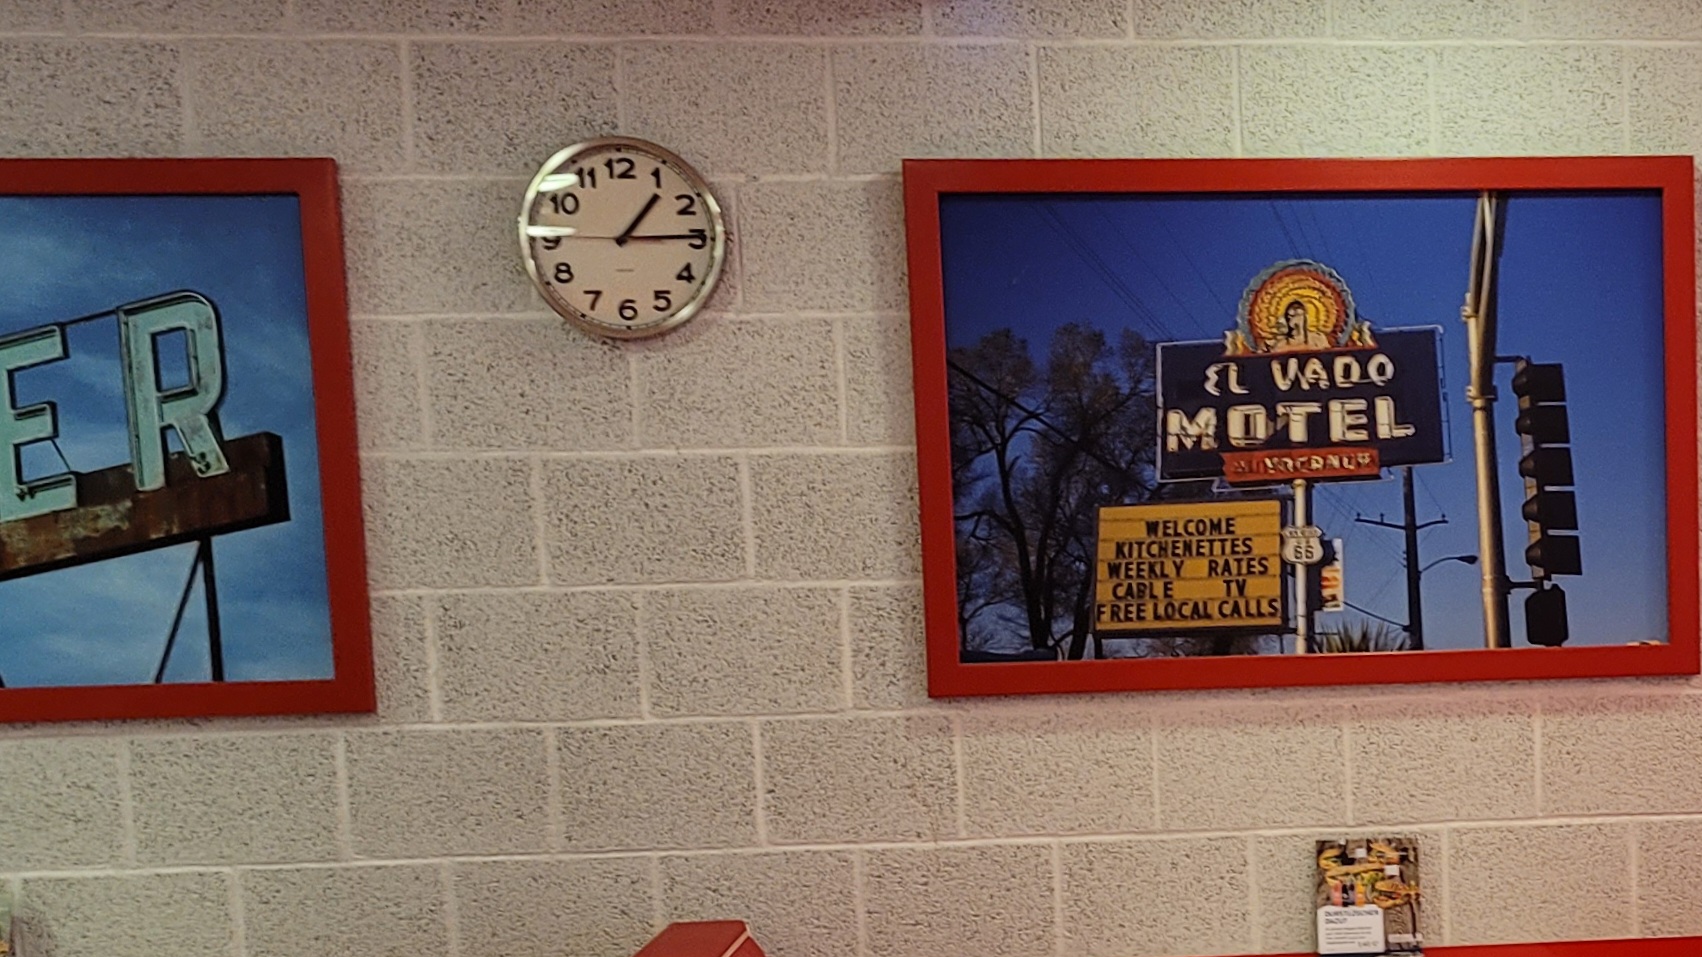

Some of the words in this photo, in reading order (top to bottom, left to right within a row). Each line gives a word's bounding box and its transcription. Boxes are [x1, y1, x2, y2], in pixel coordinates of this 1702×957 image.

[577, 167, 597, 188] 11
[604, 158, 636, 179] 12
[651, 167, 662, 188] 1
[550, 193, 580, 215] 10
[675, 194, 697, 216] 2
[688, 229, 707, 249] 3
[554, 262, 574, 283] 8
[676, 262, 696, 283] 4
[583, 290, 603, 311] 7
[618, 299, 638, 320] 6
[653, 290, 672, 312] 5
[1204, 362, 1250, 396] EL
[1271, 353, 1395, 391] VADO
[1166, 395, 1416, 452] MOTEL
[1145, 517, 1236, 537] WELCOME
[1115, 537, 1253, 559] KITCHENETTES
[1107, 559, 1184, 579] WEEKLY
[1208, 556, 1269, 576] RATES
[1112, 580, 1174, 600] CABLE
[1223, 578, 1247, 597] TV
[1096, 602, 1147, 622] FREE
[1153, 601, 1213, 619] LOCAL
[1218, 598, 1279, 619] CALLS
